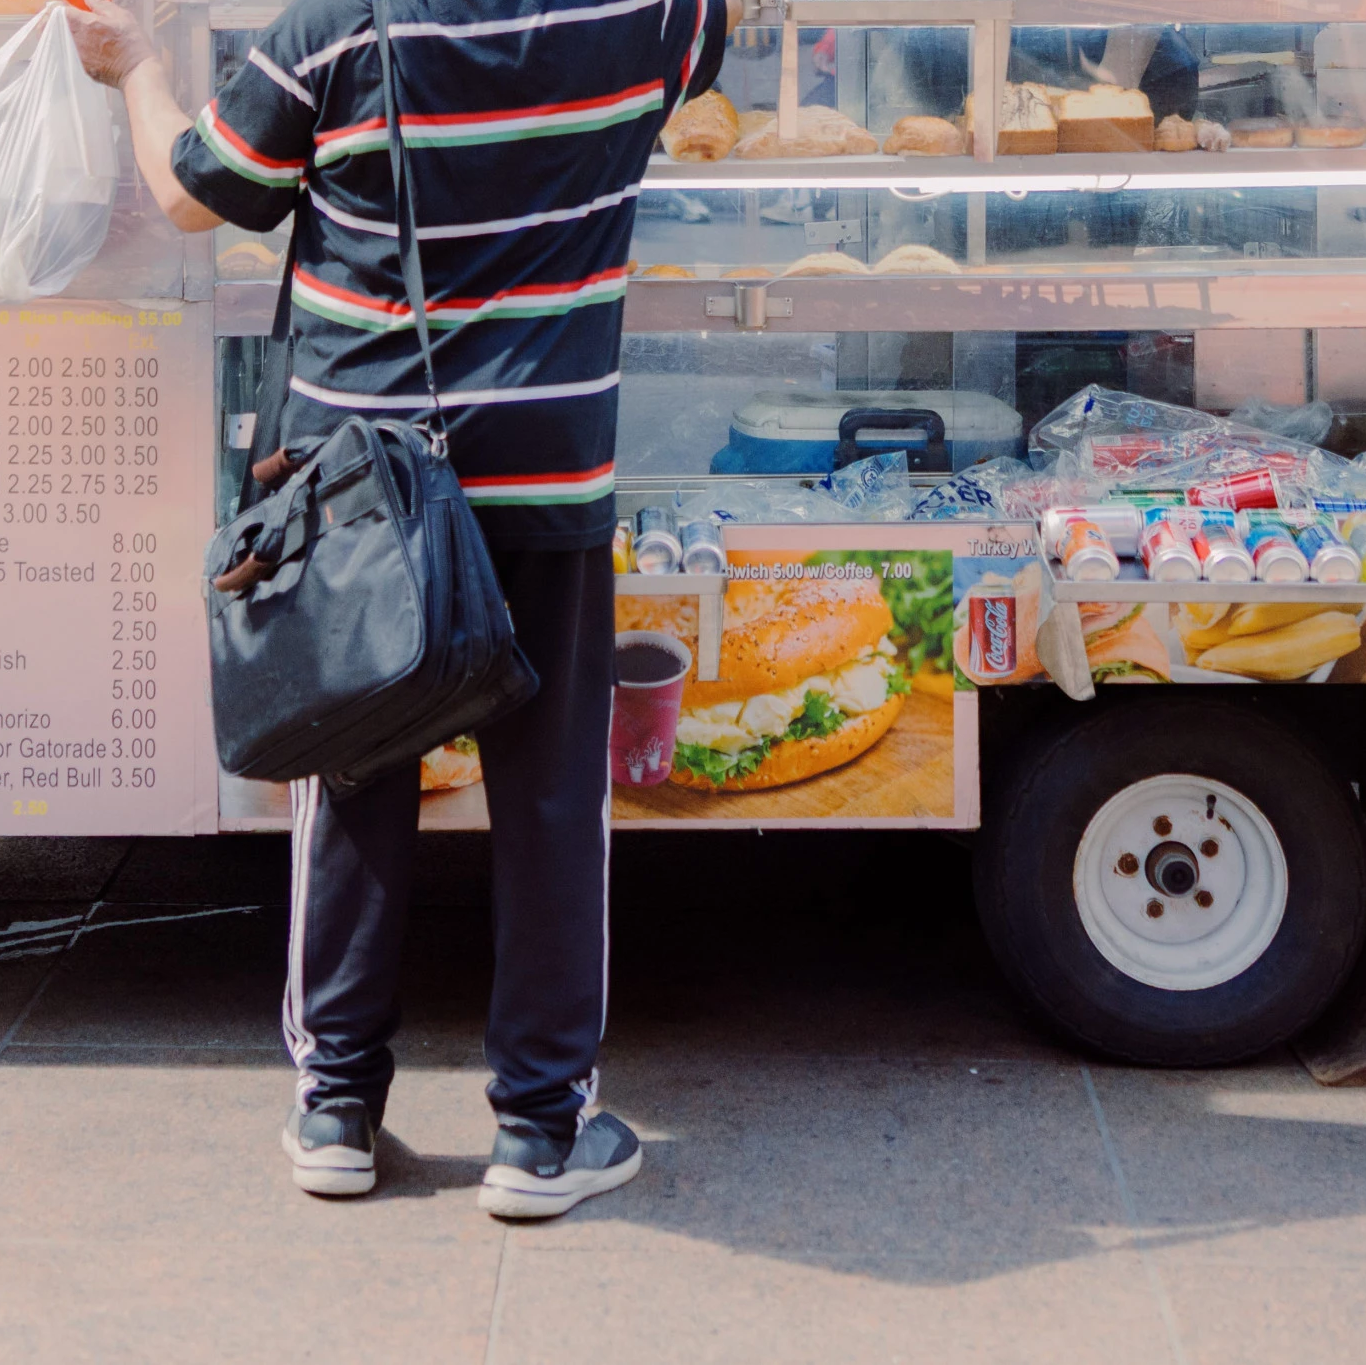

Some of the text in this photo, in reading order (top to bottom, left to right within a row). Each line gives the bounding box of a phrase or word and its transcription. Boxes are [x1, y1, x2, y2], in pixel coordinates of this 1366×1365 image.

[8, 357, 55, 379] 2.00
[62, 357, 108, 380] 2.50
[115, 357, 160, 380] 3.00
[8, 386, 54, 409] 2.25
[62, 386, 107, 409] 3.00
[115, 387, 160, 409] 3.50
[3, 503, 49, 525] 3.00
[56, 503, 102, 526] 3.50
[113, 533, 158, 555] 8.00
[967, 538, 1021, 560] Turkey
[772, 563, 913, 580] 5.00 w/Coffee 7.00
